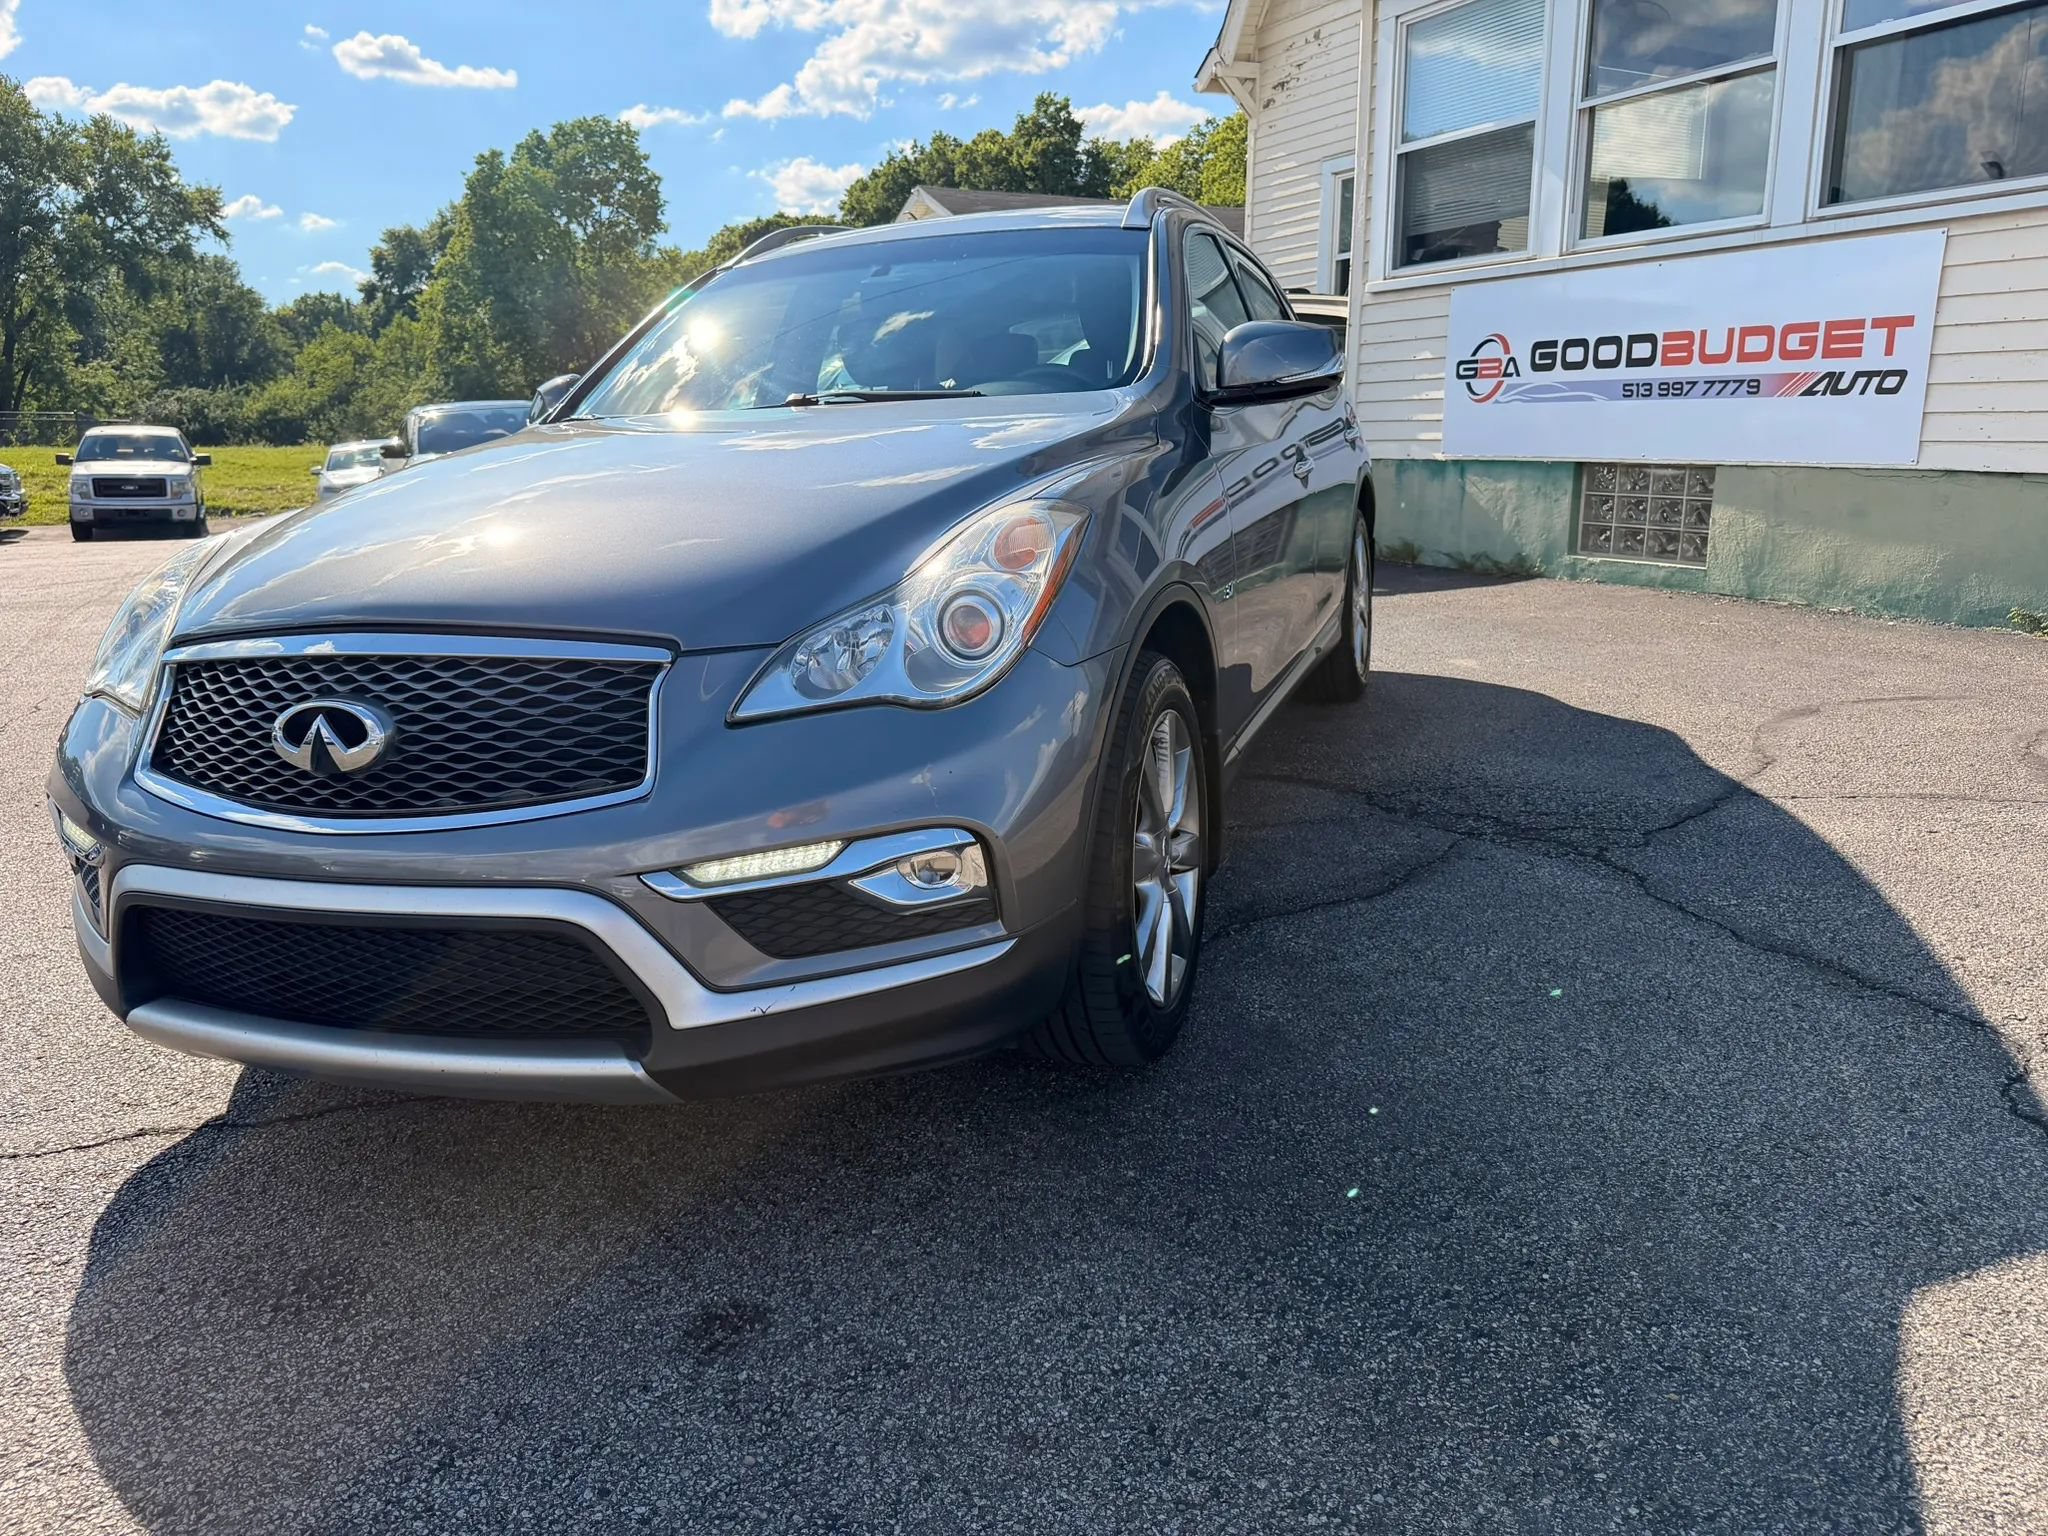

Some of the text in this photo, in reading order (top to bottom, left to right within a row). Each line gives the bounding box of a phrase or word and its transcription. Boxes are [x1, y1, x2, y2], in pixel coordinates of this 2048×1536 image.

[1456, 356, 1521, 380] GBA
[1622, 379, 1761, 398] 513 997 7779
[1798, 369, 1909, 397] AUTO
